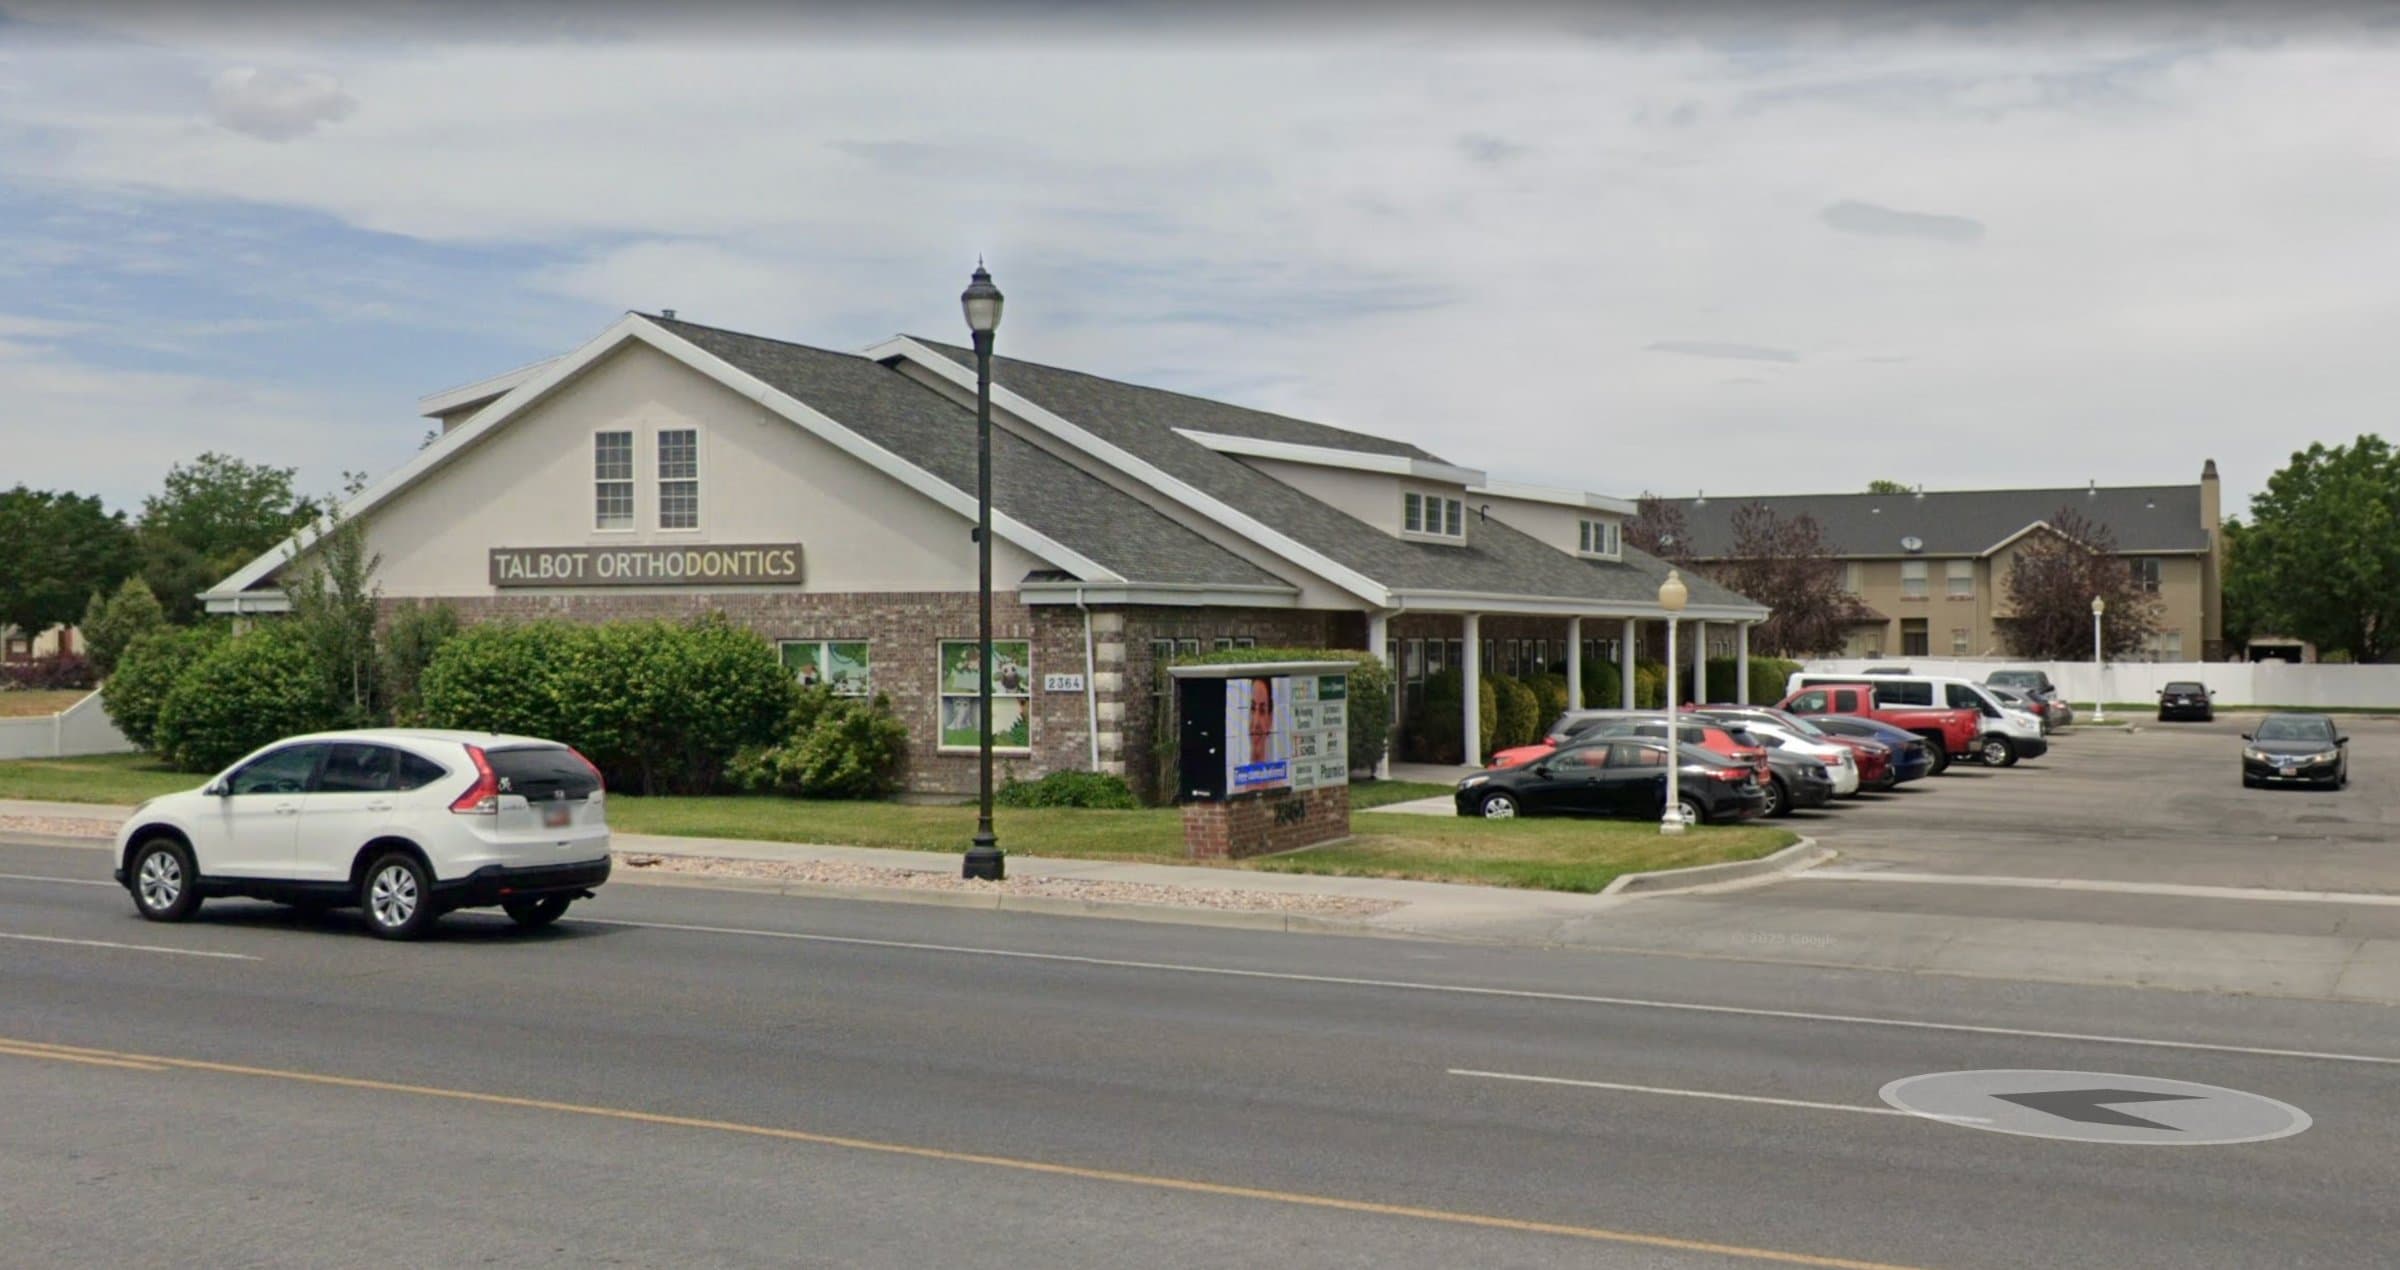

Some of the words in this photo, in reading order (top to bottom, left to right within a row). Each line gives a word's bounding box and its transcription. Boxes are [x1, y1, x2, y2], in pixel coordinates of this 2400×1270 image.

[494, 552, 589, 580] TALBOT
[596, 549, 797, 578] ORTHODONTICS
[1048, 677, 1080, 689] 2364
